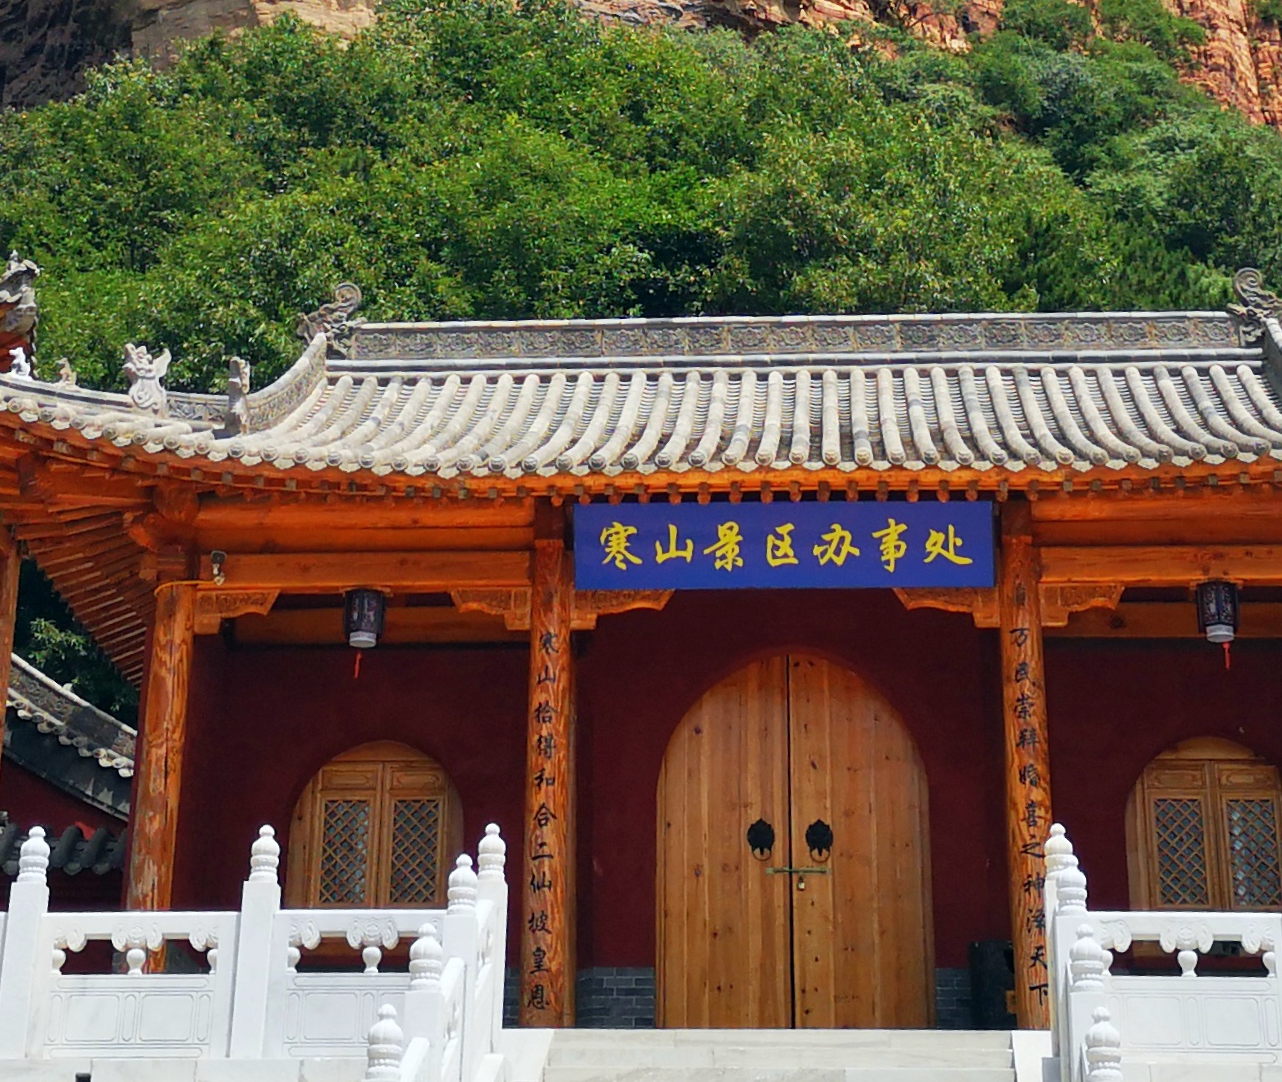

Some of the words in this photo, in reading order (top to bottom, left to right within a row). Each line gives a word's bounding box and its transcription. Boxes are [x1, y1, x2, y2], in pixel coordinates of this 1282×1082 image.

[599, 518, 974, 573] 寒山景区办事处
